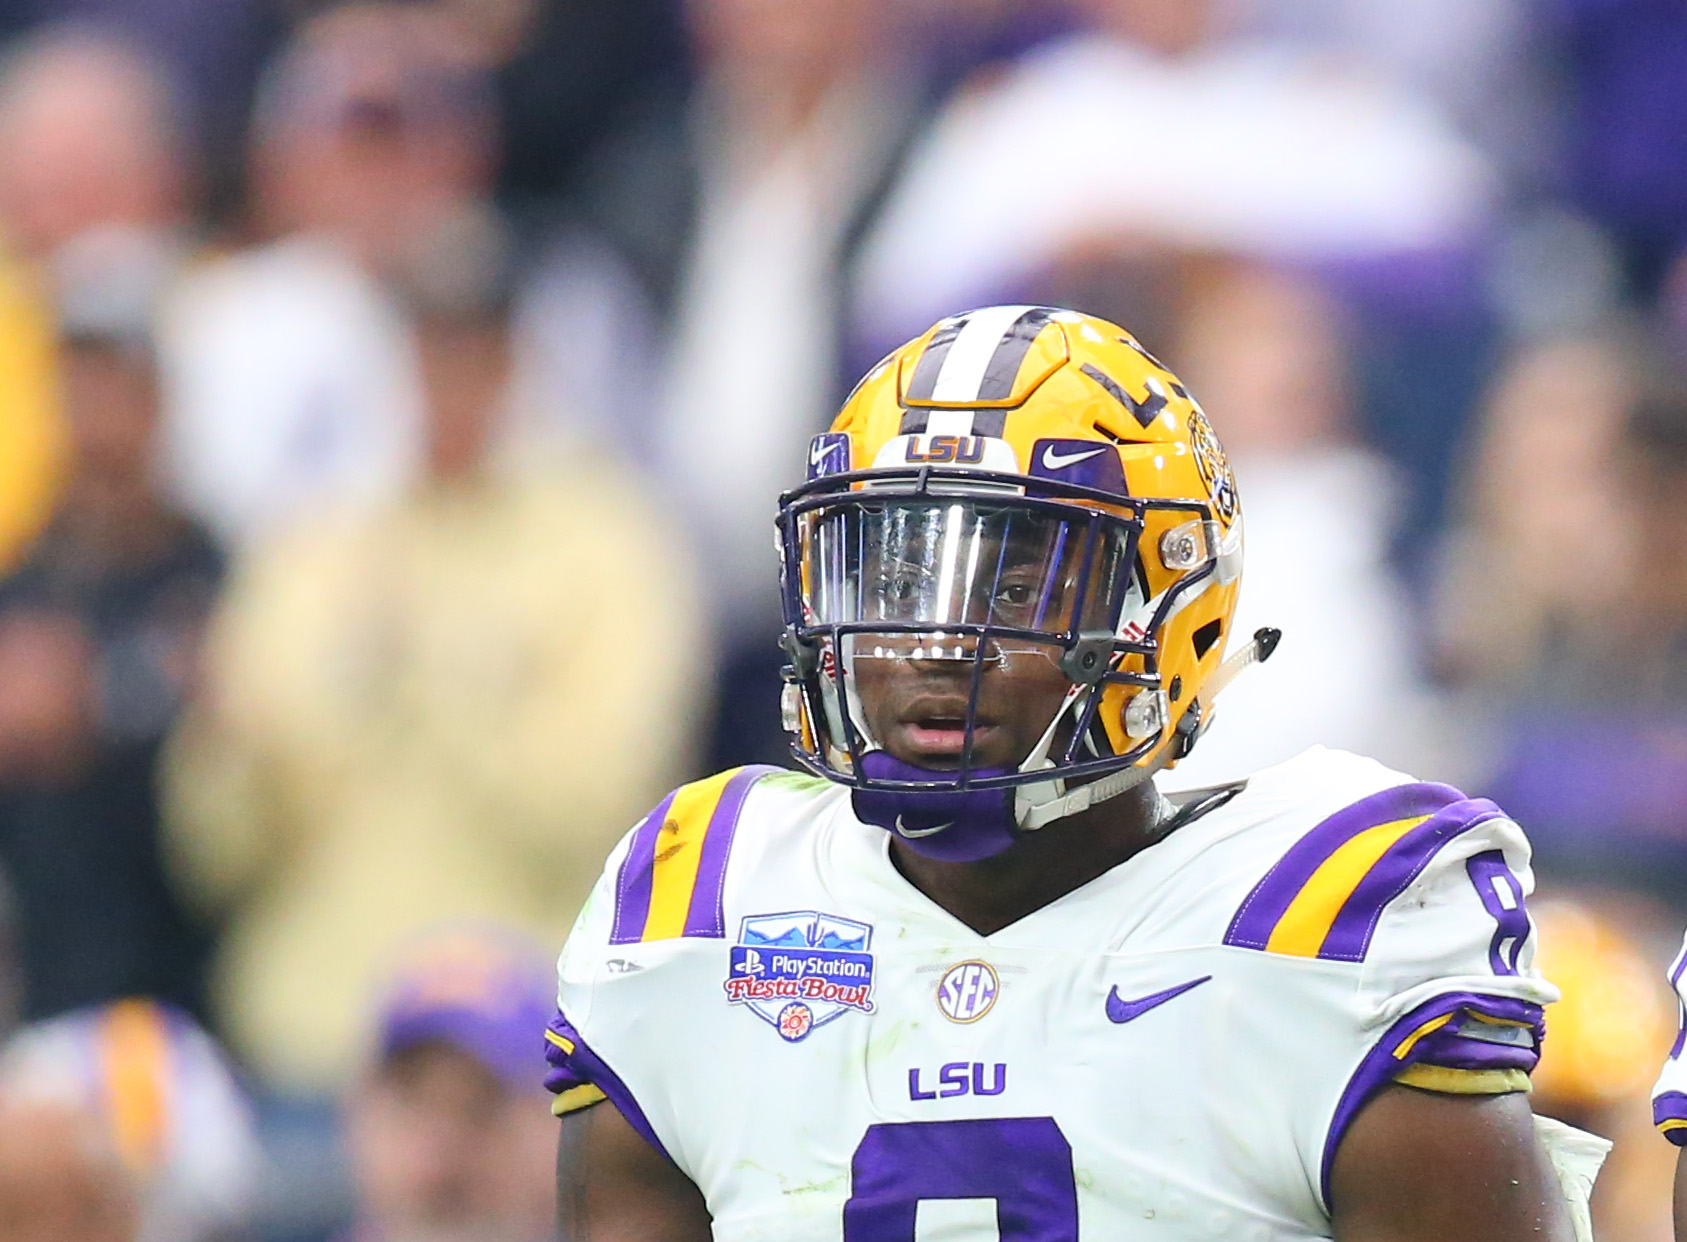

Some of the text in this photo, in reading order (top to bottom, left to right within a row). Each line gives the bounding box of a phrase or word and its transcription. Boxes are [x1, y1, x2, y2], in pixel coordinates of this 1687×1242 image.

[905, 434, 986, 465] LSU
[1465, 848, 1530, 976] 8
[772, 955, 866, 979] PlayStation
[728, 976, 867, 1005] Fiesta Bowl
[940, 965, 996, 1018] SEC
[909, 1062, 1007, 1100] LSU
